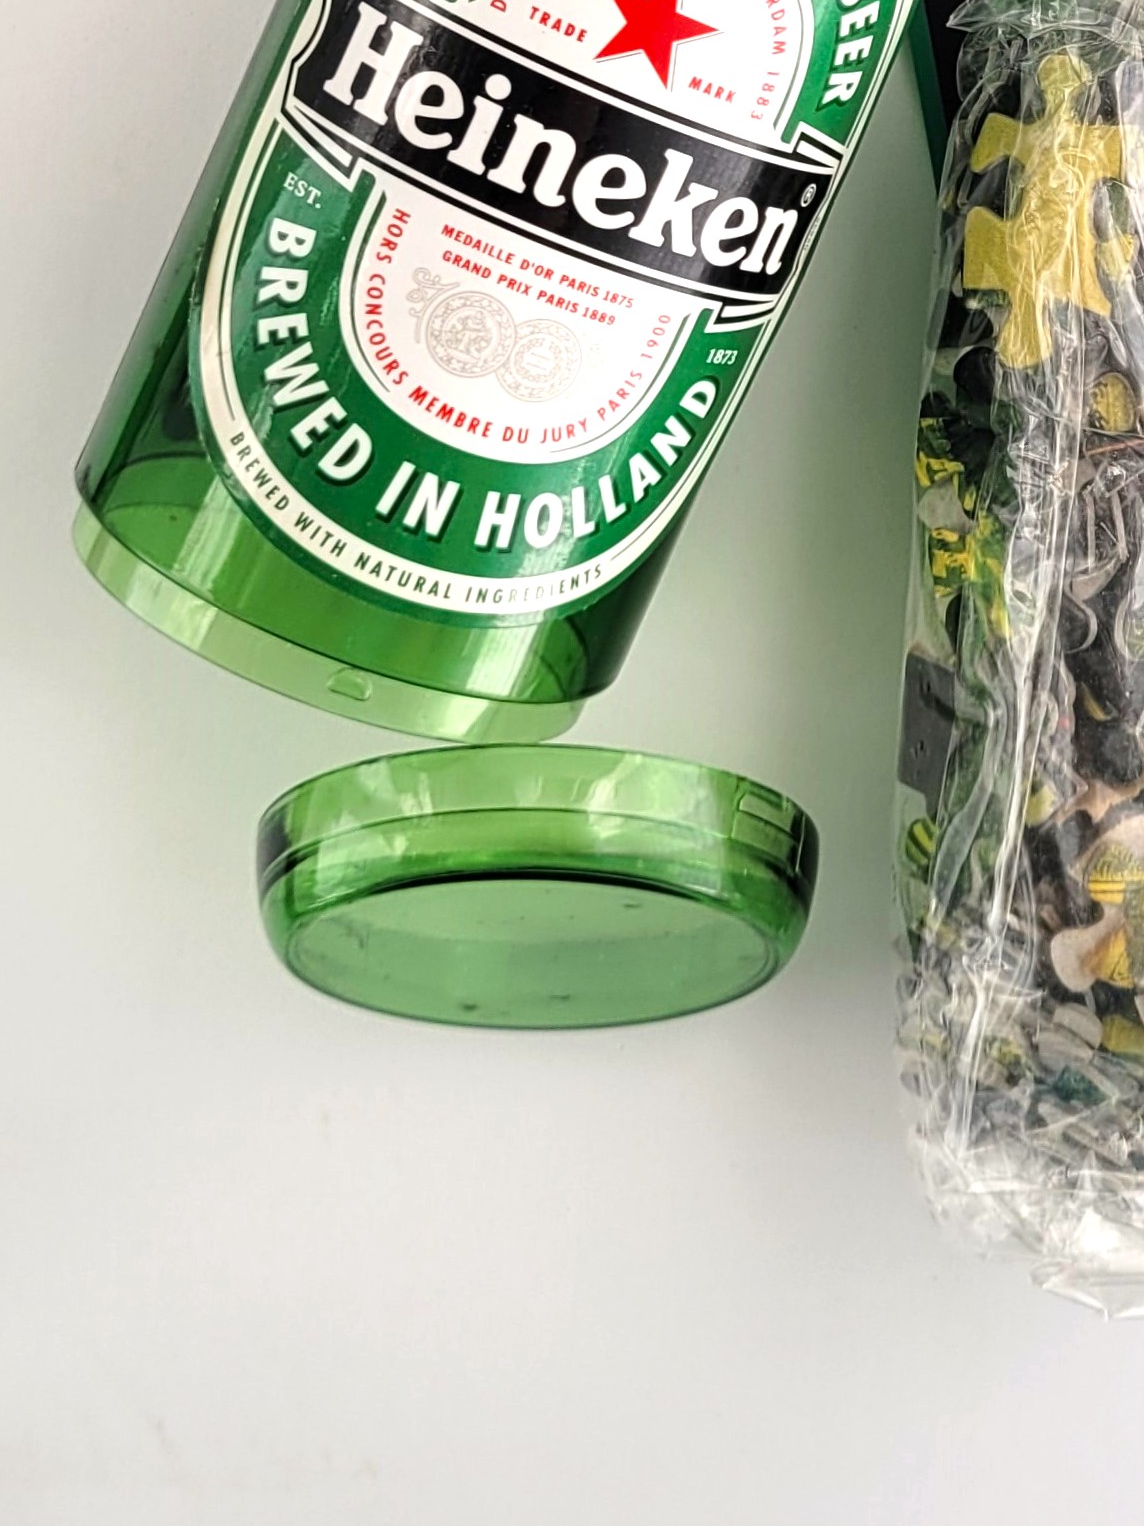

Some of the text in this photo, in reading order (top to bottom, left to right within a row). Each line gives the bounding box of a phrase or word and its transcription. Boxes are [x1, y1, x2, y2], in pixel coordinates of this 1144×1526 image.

[529, 5, 589, 43] TRADE
[688, 75, 737, 104] MARK
[750, 71, 780, 122] 1883
[322, 0, 800, 276] Heineken
[283, 172, 322, 210] EST.
[373, 207, 412, 265] HORS
[440, 224, 635, 309] MEDAILLE D'OR PARIS 1875
[441, 249, 617, 326] GRAND PRIX PARIS 1889
[364, 272, 409, 387] CONCOURS
[639, 313, 672, 365] 1900
[705, 348, 738, 366] 1873
[256, 218, 719, 551] BREWED IN HOLLAND
[407, 384, 493, 440] MEMBRE
[597, 368, 645, 423] PARIS
[501, 424, 530, 445] DU
[539, 417, 590, 445] JURY
[229, 430, 604, 606] BREWED WITH NATURAL INGREDIENTS
